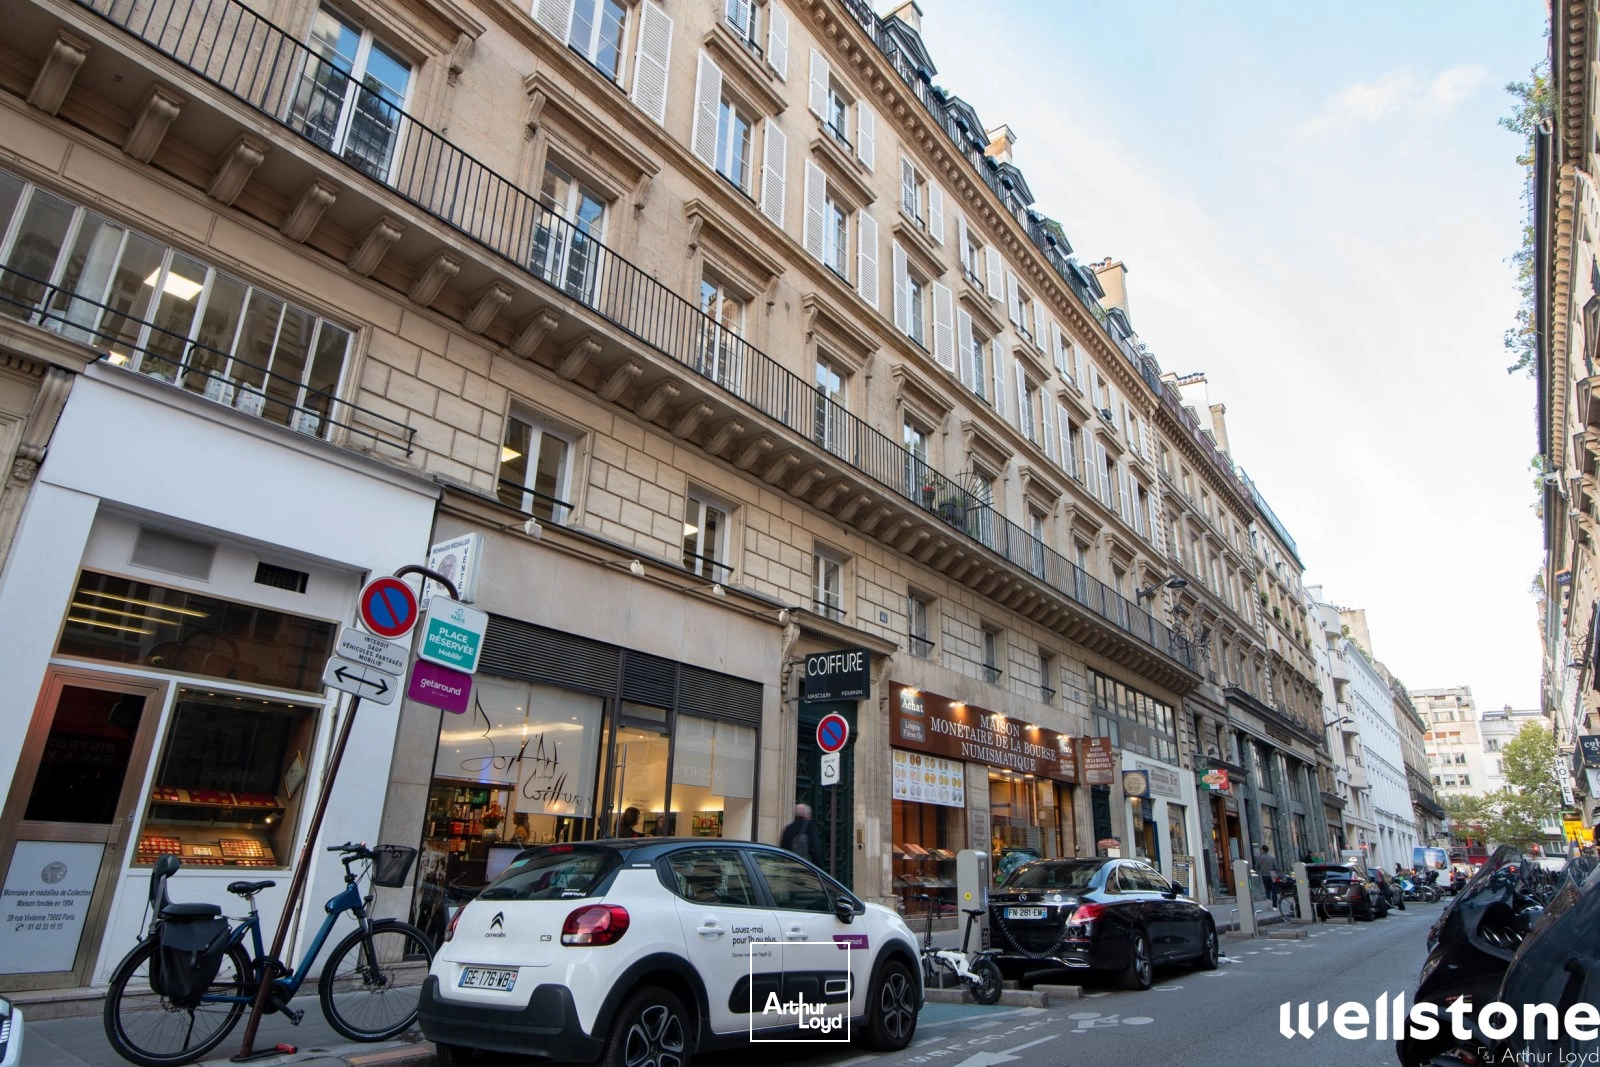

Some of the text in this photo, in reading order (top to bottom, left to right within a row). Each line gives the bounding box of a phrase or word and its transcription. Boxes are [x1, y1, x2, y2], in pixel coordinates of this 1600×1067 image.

[451, 614, 465, 624] PARIS
[364, 636, 390, 649] INTERDIT
[439, 627, 468, 643] PLACE
[342, 642, 402, 666] VÉHICULES PARTAGÉS
[368, 644, 382, 652] SAUF
[429, 634, 474, 656] RÉSERVÉE
[808, 652, 862, 676] COIFFURE
[420, 678, 462, 696] getaround
[902, 697, 923, 713] Achat
[980, 714, 1020, 738] MAISON
[930, 716, 1056, 762] MONÉTAIRE DE LA BOURSE
[960, 742, 1036, 772] NUMISMATIQUE
[1556, 760, 1572, 803] HOTEL
[732, 925, 764, 933] Louez-moi
[733, 937, 747, 946] pour
